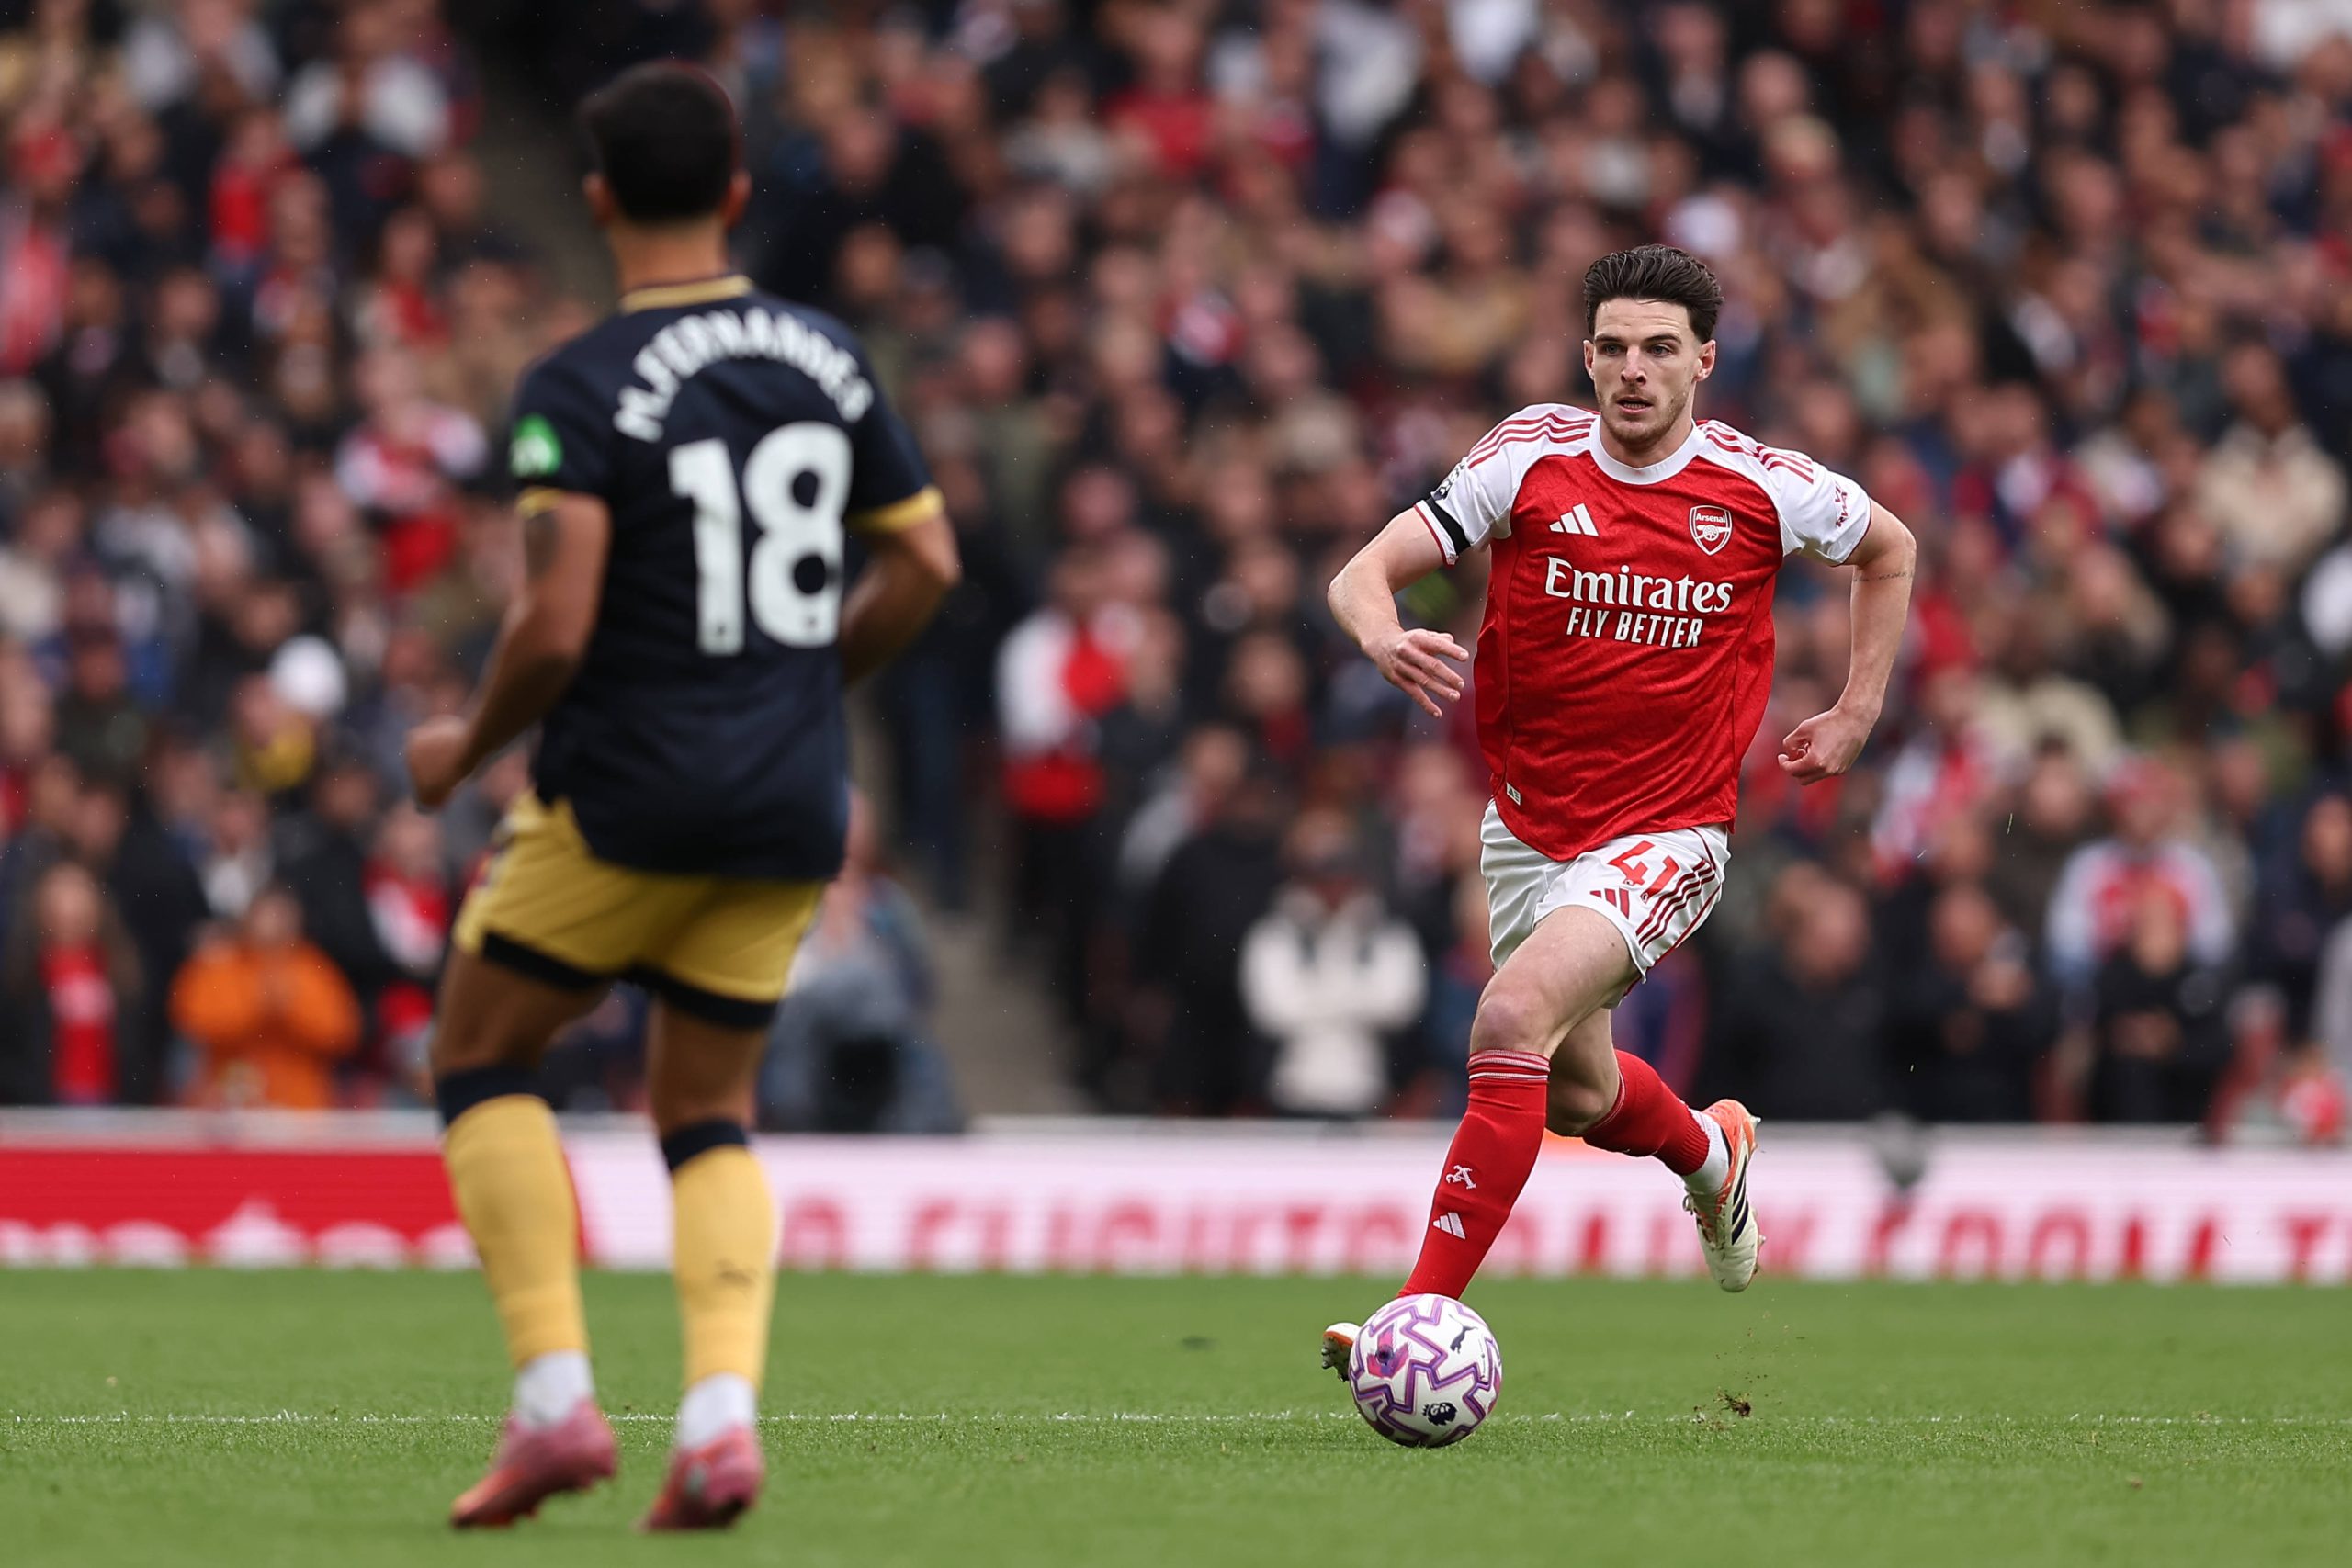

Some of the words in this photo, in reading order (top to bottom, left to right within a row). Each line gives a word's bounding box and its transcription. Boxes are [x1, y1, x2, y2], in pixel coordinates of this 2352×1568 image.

[668, 421, 853, 655] 18
[1695, 513, 1726, 524] Arsenal
[1545, 556, 1734, 614] Emirates
[1566, 606, 1611, 638] FLY
[1614, 611, 1703, 648] BETTER
[1607, 840, 1680, 904] 41
